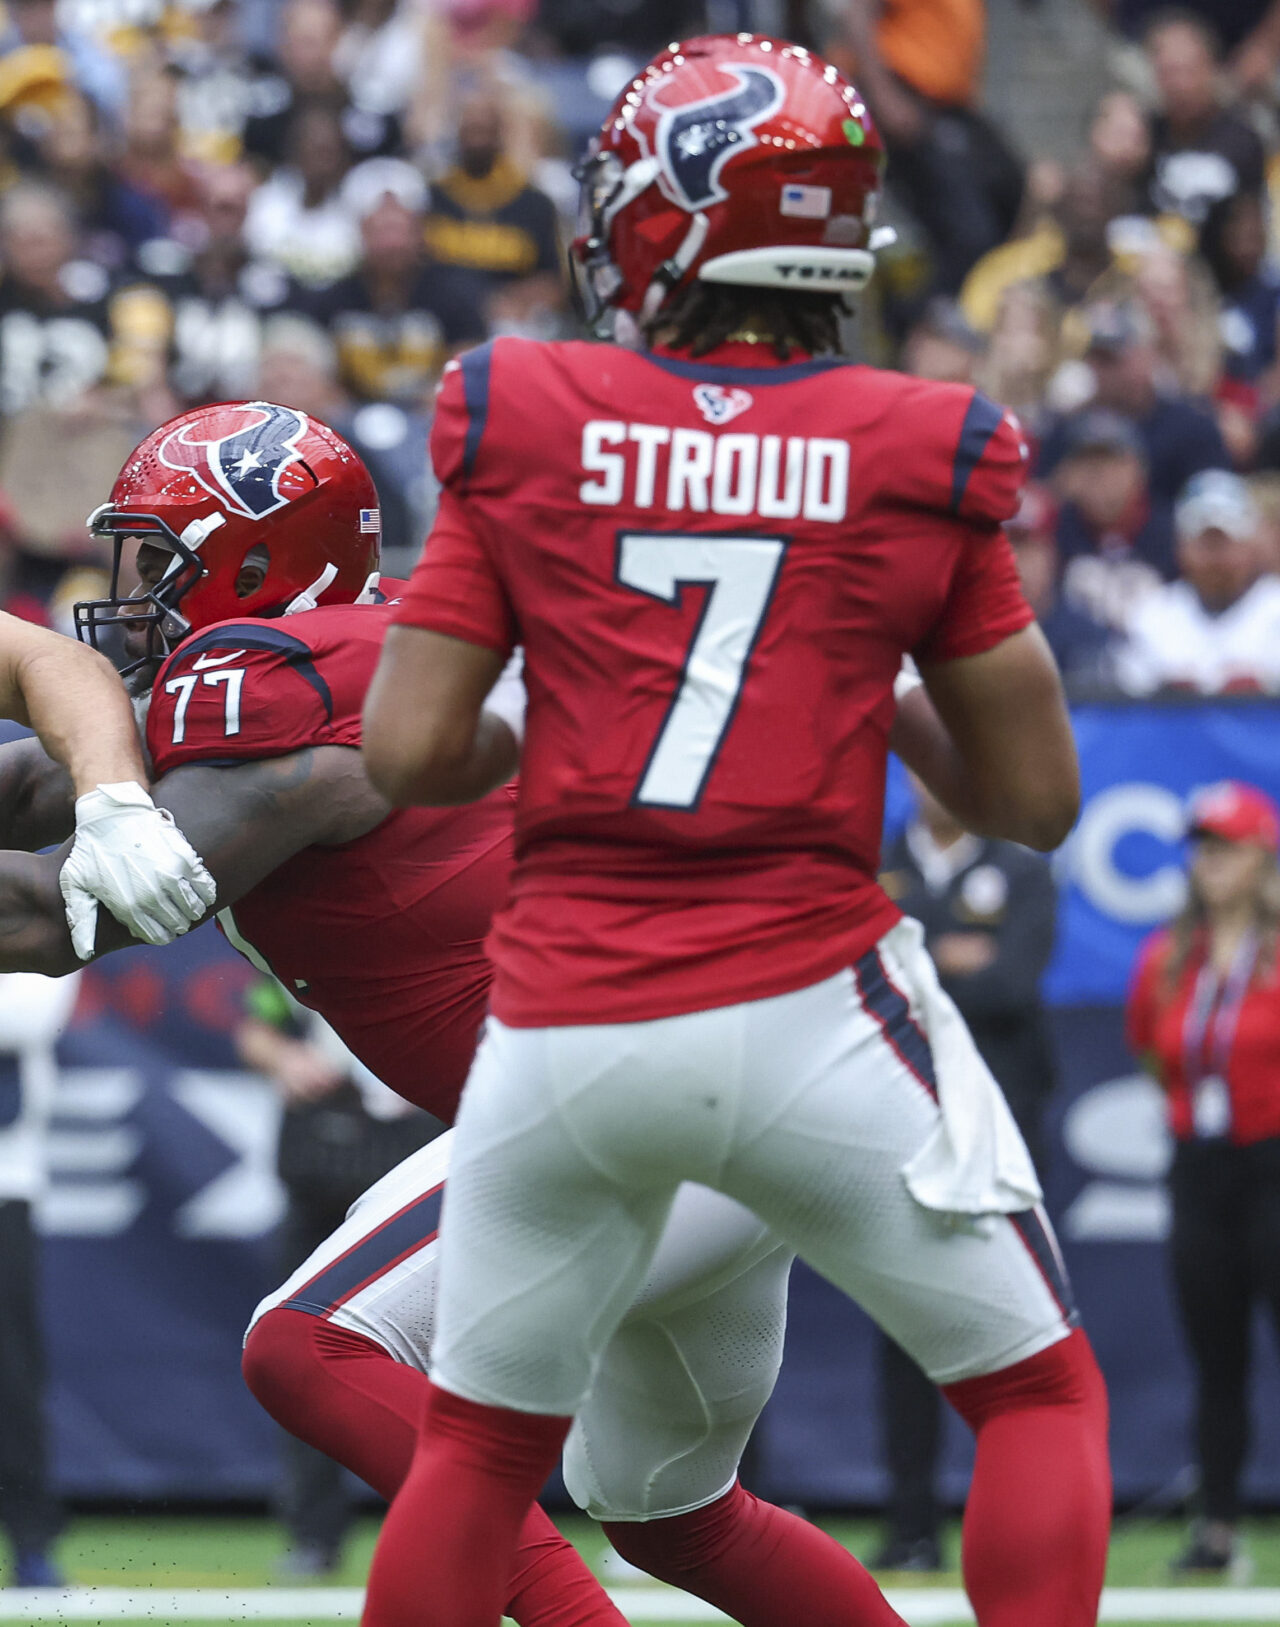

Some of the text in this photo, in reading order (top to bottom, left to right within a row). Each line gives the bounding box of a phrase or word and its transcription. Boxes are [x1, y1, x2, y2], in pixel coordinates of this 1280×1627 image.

[579, 420, 850, 523] STROUD
[165, 667, 247, 745] 77
[615, 529, 792, 814] 7
